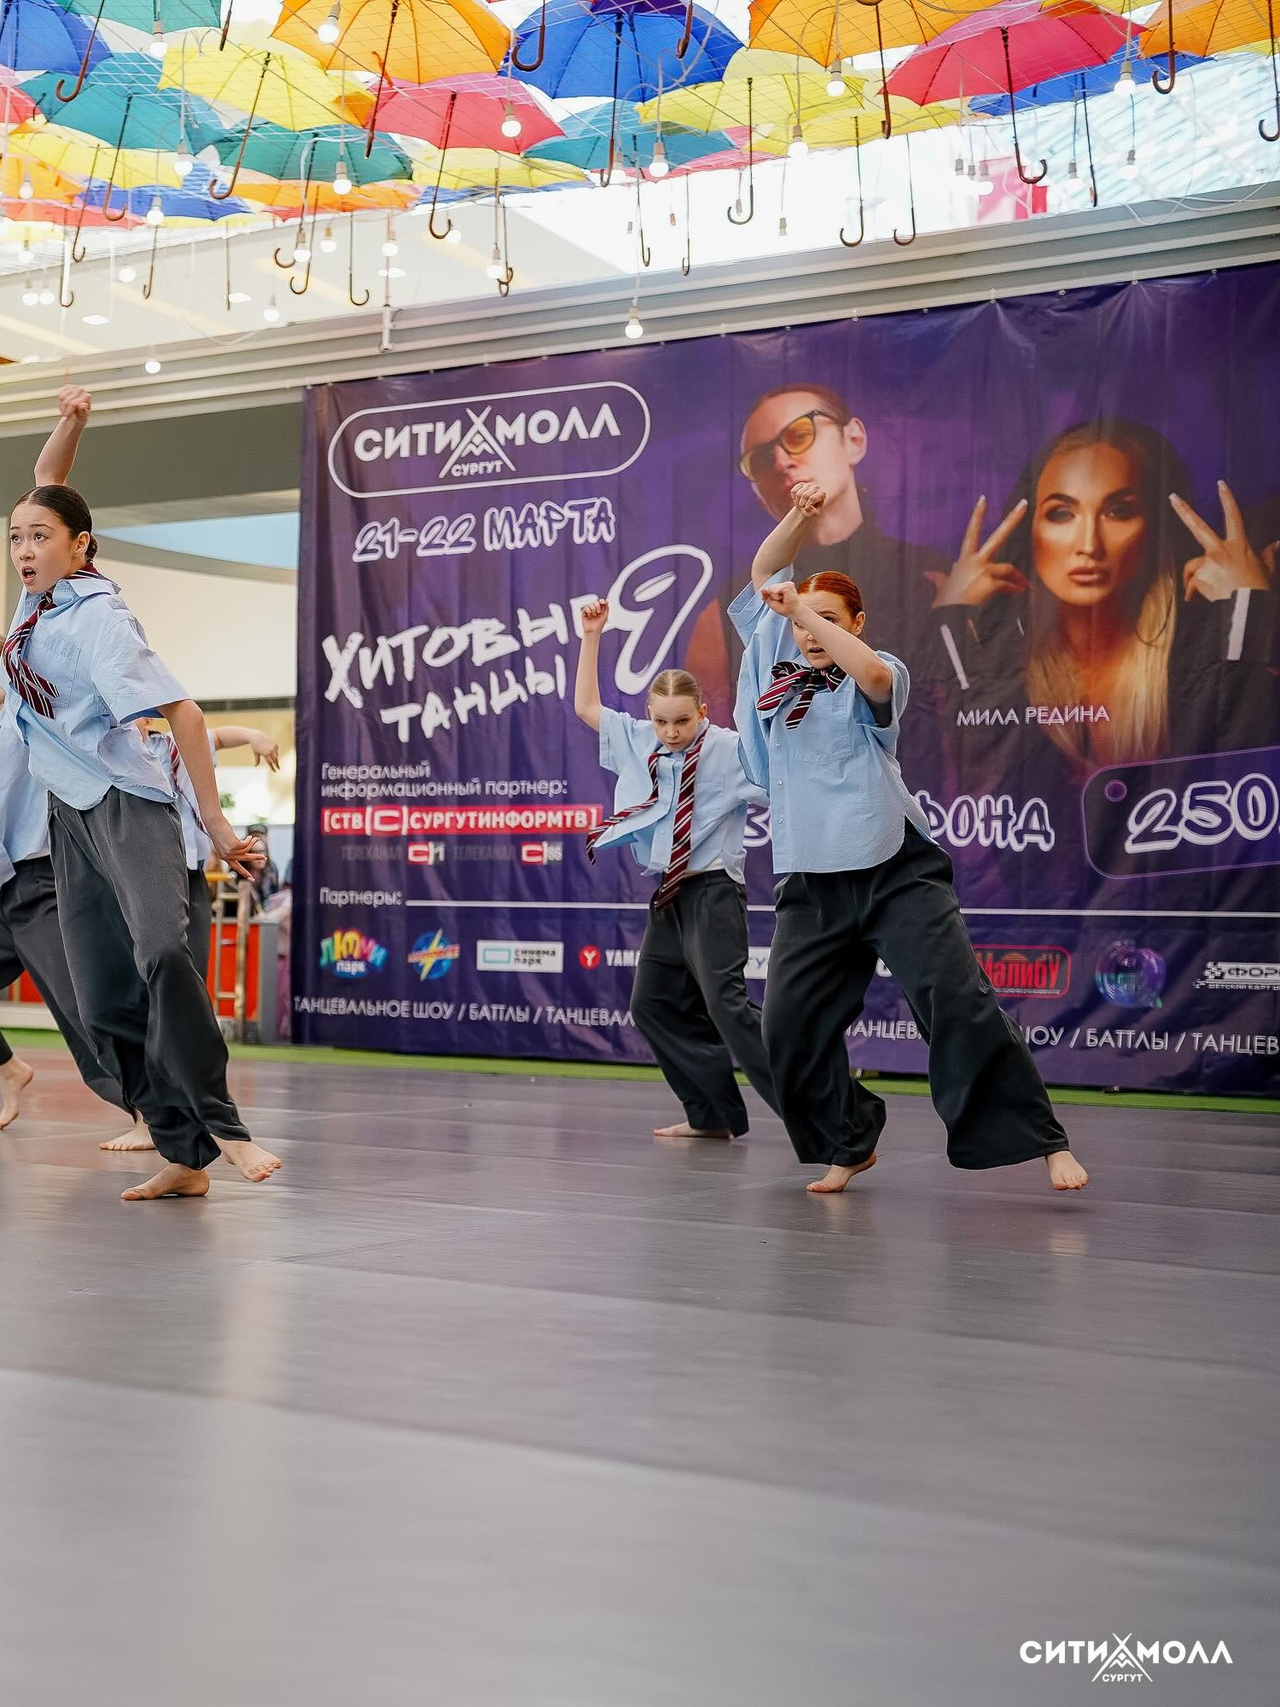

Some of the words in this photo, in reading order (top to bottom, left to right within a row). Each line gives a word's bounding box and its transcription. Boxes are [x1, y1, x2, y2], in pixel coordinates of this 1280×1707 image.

[354, 419, 462, 462] СИТИ
[496, 403, 621, 446] МОЛЛ
[451, 459, 504, 477] СУРГУТ
[352, 513, 477, 562] 21-22
[484, 497, 616, 551] МАРТА
[381, 654, 567, 742] ТАНЦЫ
[956, 708, 1019, 726] МИЛА
[1024, 704, 1110, 725] РЕДИНА
[321, 760, 431, 781] Генеральный
[321, 777, 480, 800] информационный
[485, 780, 568, 798] партнер:
[320, 887, 402, 908] Партнеры:
[1228, 967, 1280, 977] ФОР
[294, 996, 409, 1018] ТАНЦЕВАЛЬНОЕ
[413, 1001, 454, 1021] ШОУ
[469, 1003, 530, 1022] БАТТЛЫ
[844, 1019, 922, 1041] АНЦЕВ
[1085, 1027, 1168, 1050] БАТТЛЫ
[1192, 1032, 1280, 1056] ТАНЦЕВ
